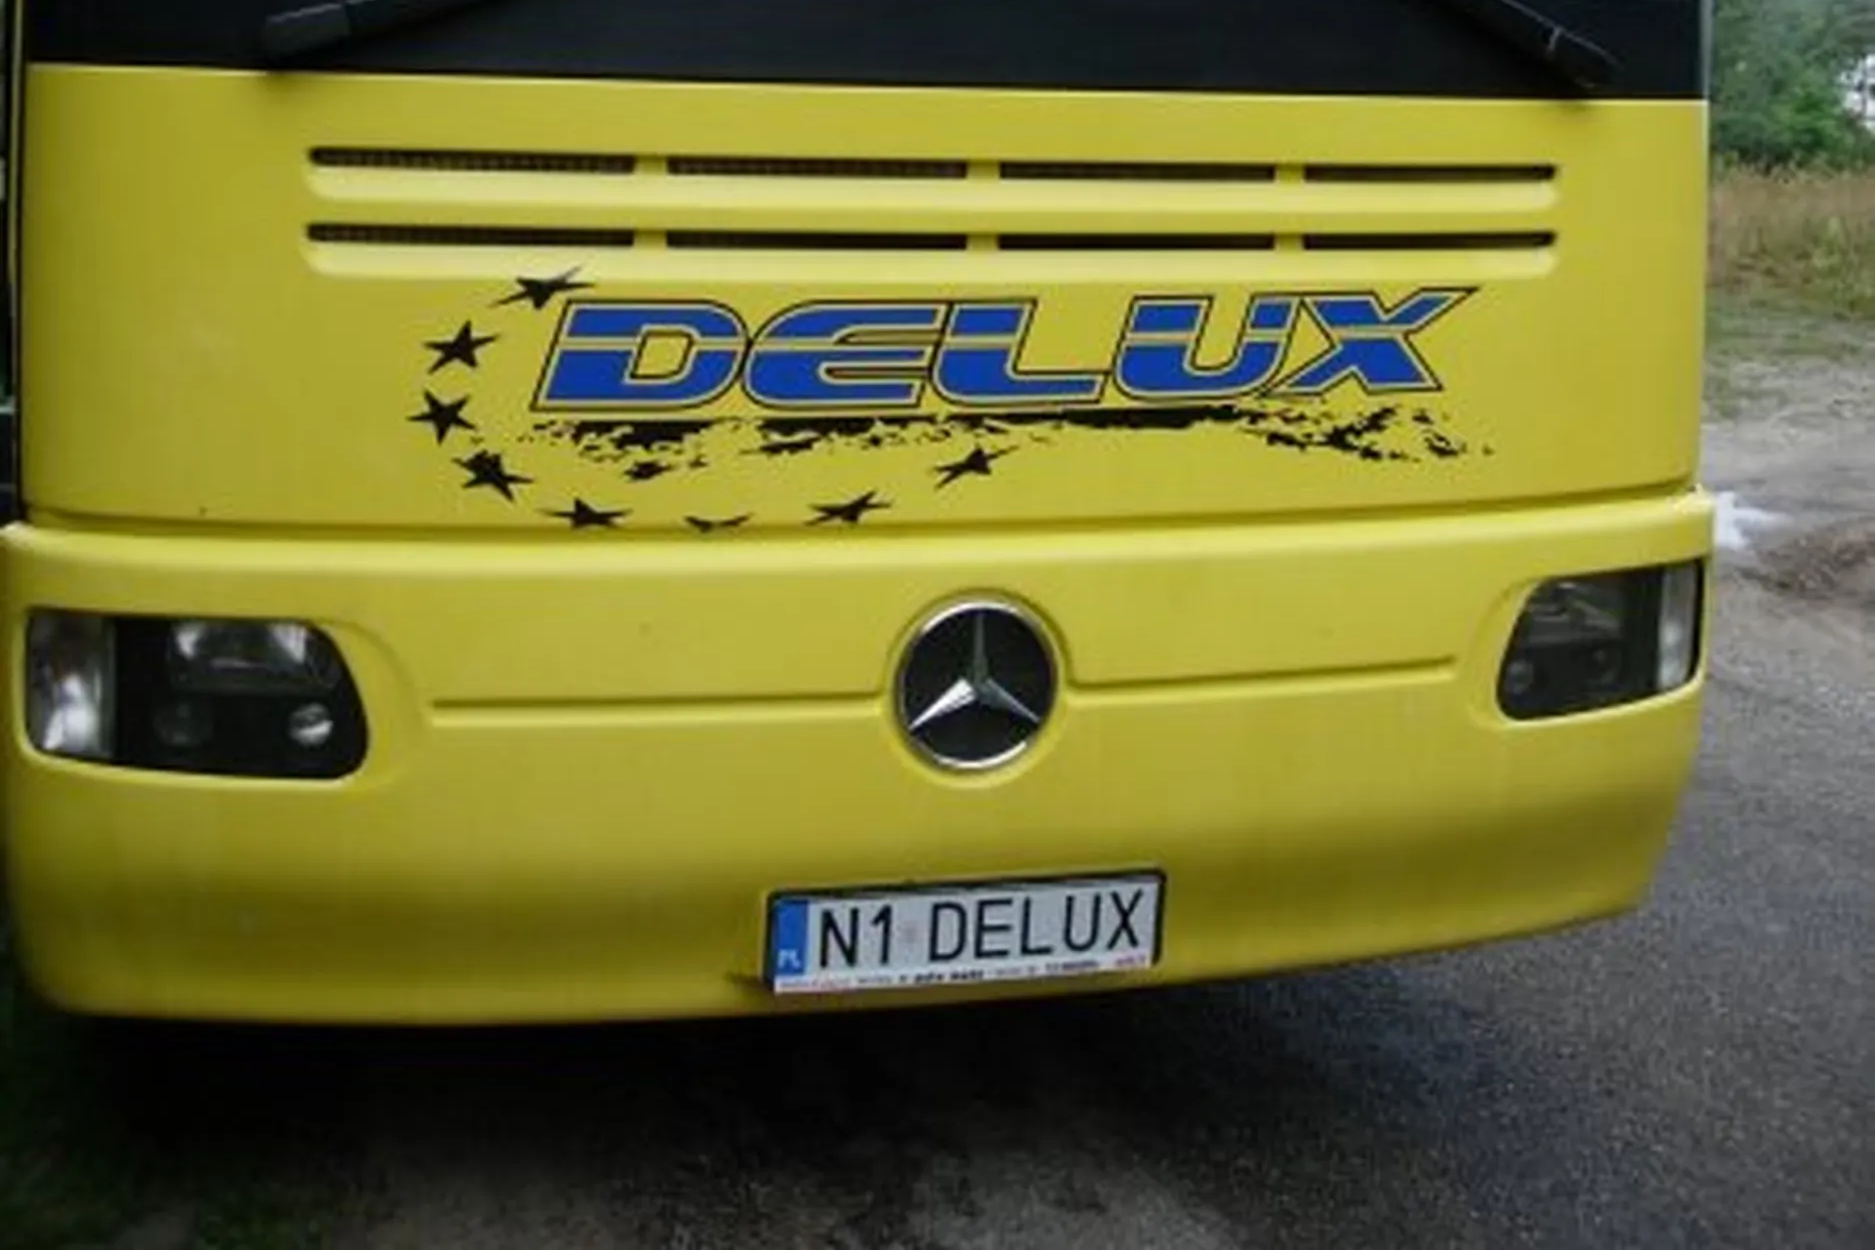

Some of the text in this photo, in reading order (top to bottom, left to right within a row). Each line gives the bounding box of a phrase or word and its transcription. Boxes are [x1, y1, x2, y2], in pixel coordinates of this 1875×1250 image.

[530, 286, 1479, 411] DELUX
[819, 888, 1143, 969] N1 DELUX
